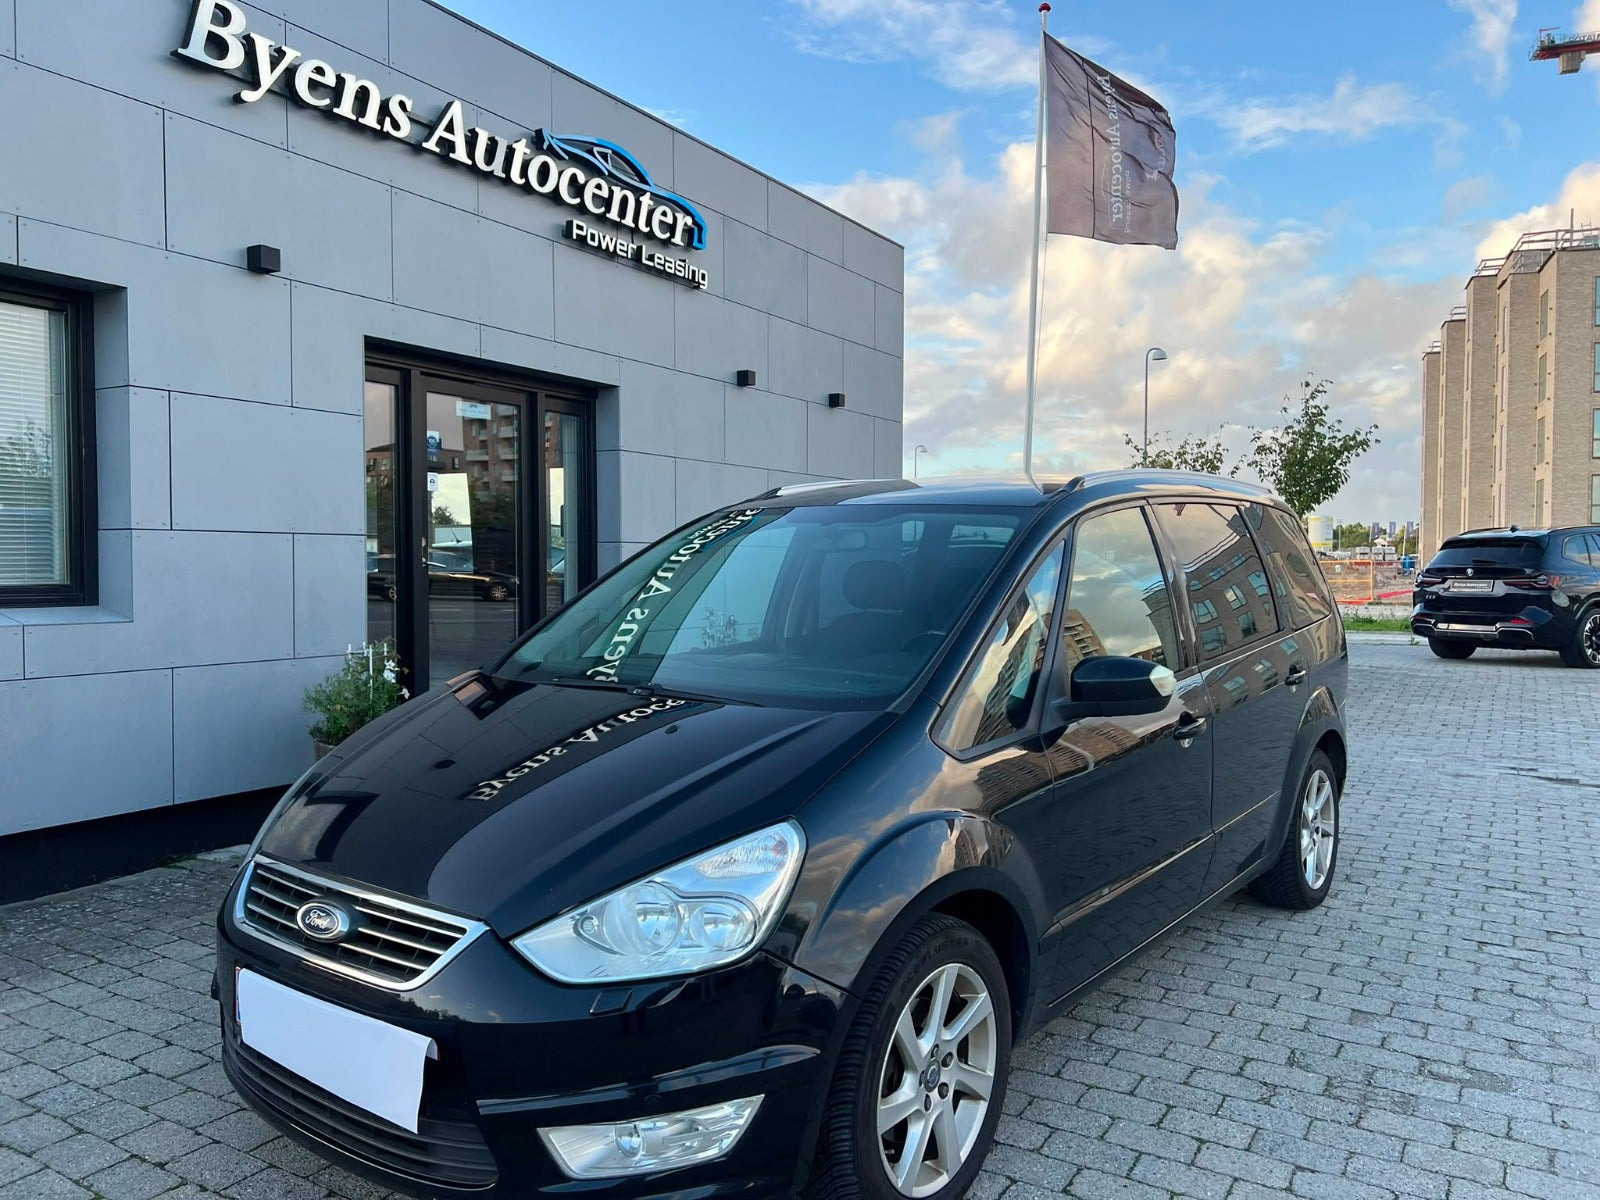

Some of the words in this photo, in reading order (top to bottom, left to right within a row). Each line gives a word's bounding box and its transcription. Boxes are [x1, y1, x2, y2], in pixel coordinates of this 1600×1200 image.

[178, 0, 412, 139] Byens
[422, 99, 693, 247] Autocenter
[572, 219, 637, 259] Power
[641, 244, 708, 290] Leasing
[305, 909, 331, 930] Ford
